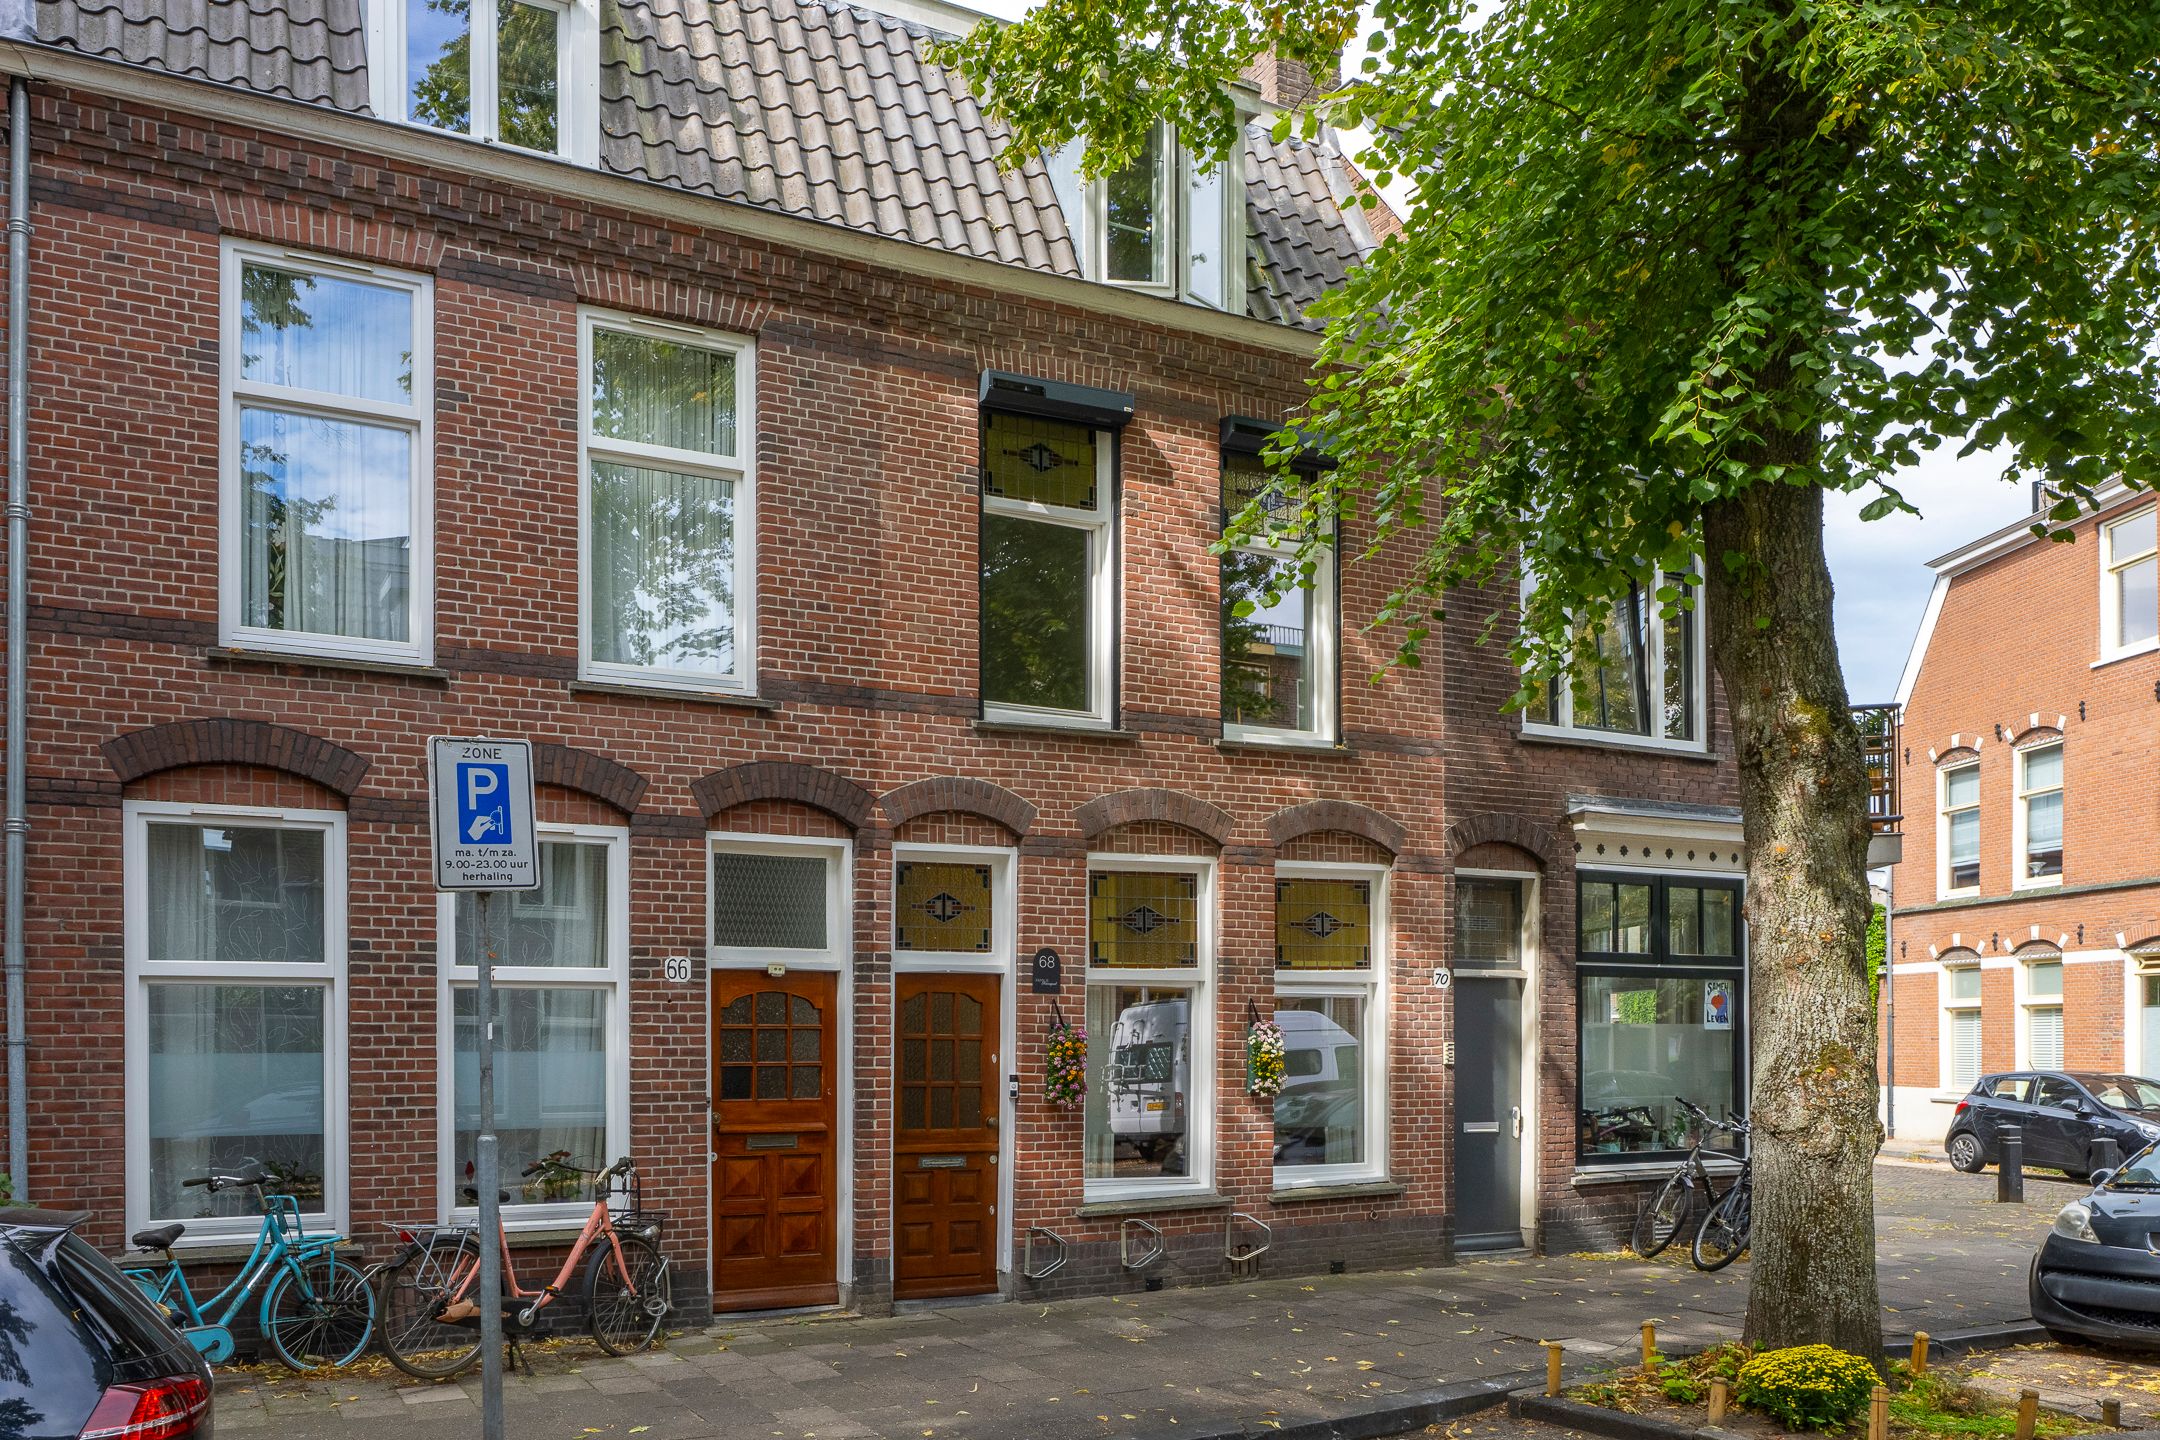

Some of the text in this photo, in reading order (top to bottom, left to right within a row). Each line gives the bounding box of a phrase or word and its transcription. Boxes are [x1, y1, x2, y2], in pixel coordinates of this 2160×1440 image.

[462, 748, 502, 760] ZONE
[468, 768, 498, 810] P
[478, 848, 498, 857] t/m
[445, 860, 507, 868] 9.00-23.00
[462, 872, 513, 882] herhaling
[1039, 956, 1055, 968] 68
[667, 958, 688, 980] 66
[1435, 974, 1448, 984] 70
[1707, 982, 1729, 996] SAMEN
[1706, 1009, 1729, 1024] LEVEN
